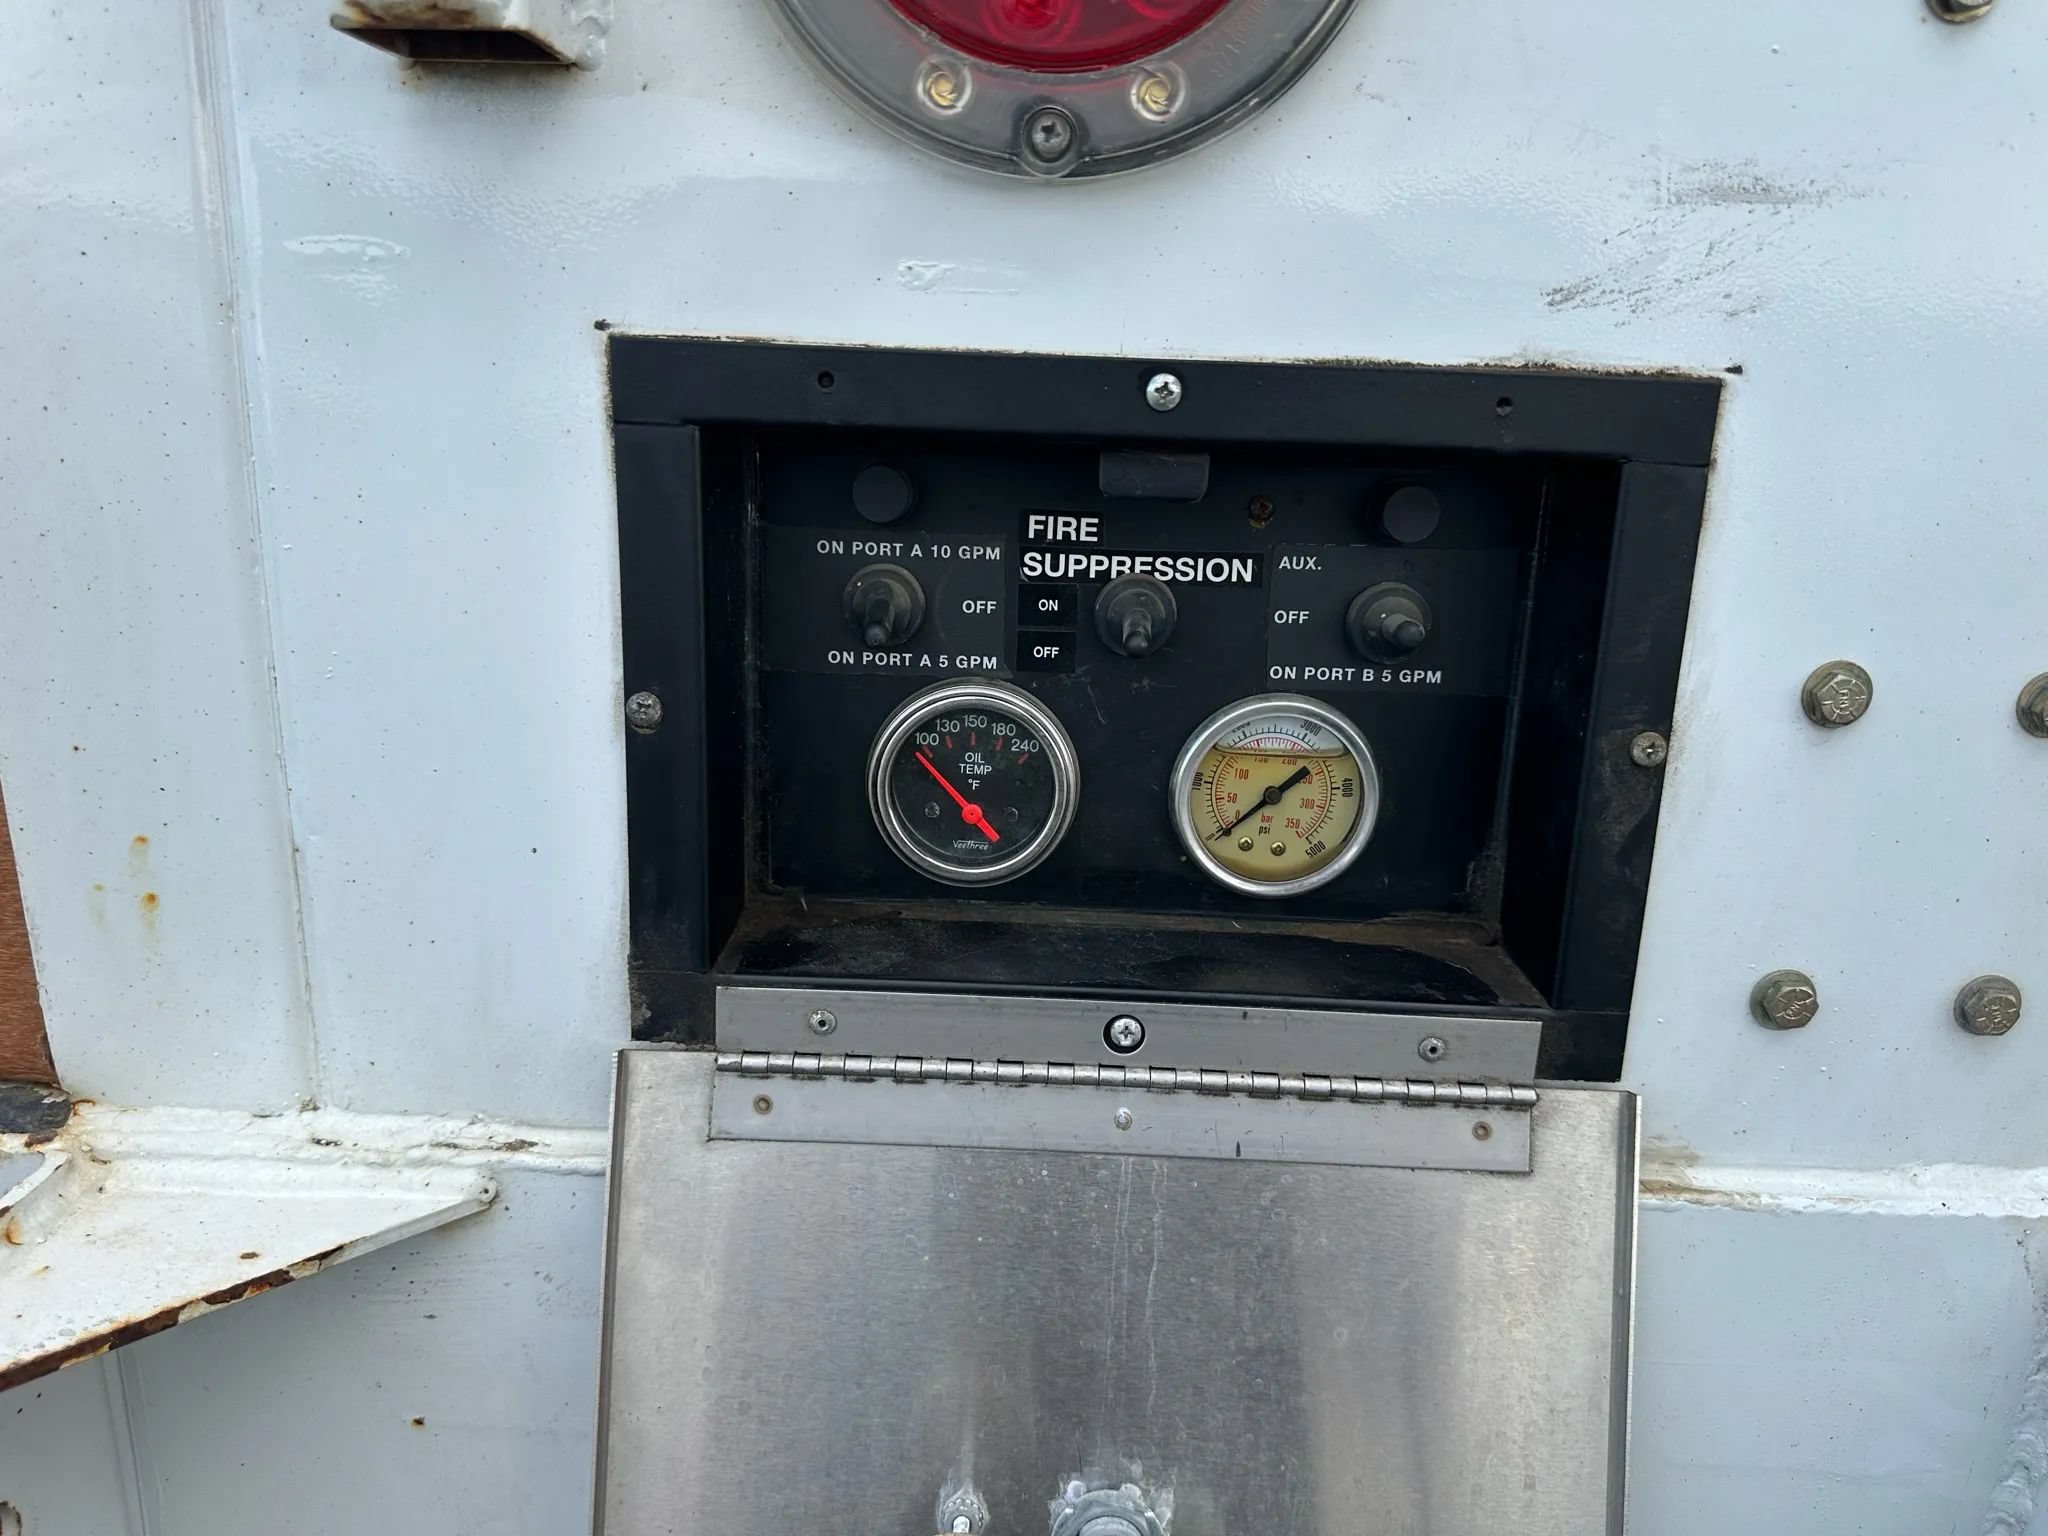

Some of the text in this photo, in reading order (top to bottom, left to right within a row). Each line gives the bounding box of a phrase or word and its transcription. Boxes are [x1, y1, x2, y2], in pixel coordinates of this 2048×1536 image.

[1028, 514, 1099, 542] FIRE
[816, 539, 1000, 560] ON PORT A 10 GPM
[1022, 551, 1253, 582] SUPPRESSION
[1278, 556, 1322, 571] AUX.
[962, 600, 997, 615] OFF
[1038, 598, 1058, 612] ON
[1273, 610, 1310, 624] OFF
[828, 649, 998, 670] ON PORT A 5 GPM
[1033, 646, 1060, 659] OFF
[1269, 665, 1442, 684] ON PORT B 5 GPM
[935, 719, 960, 733] 130
[963, 715, 987, 728] 150
[1300, 719, 1322, 737] 3000
[991, 722, 1016, 737] 180
[915, 732, 940, 746] 100
[1010, 739, 1039, 753] 240
[964, 752, 985, 763] OIL
[958, 763, 992, 775] TEMP
[1234, 768, 1249, 780] 100
[1299, 774, 1313, 785] 50
[1341, 777, 1353, 798] 4000
[1226, 792, 1238, 803] 50
[1299, 797, 1315, 810] 300
[1234, 810, 1241, 820] 0
[1260, 812, 1274, 823] bar
[1258, 825, 1271, 835] psi
[1284, 817, 1300, 829] 350
[1305, 840, 1326, 858] 5000
